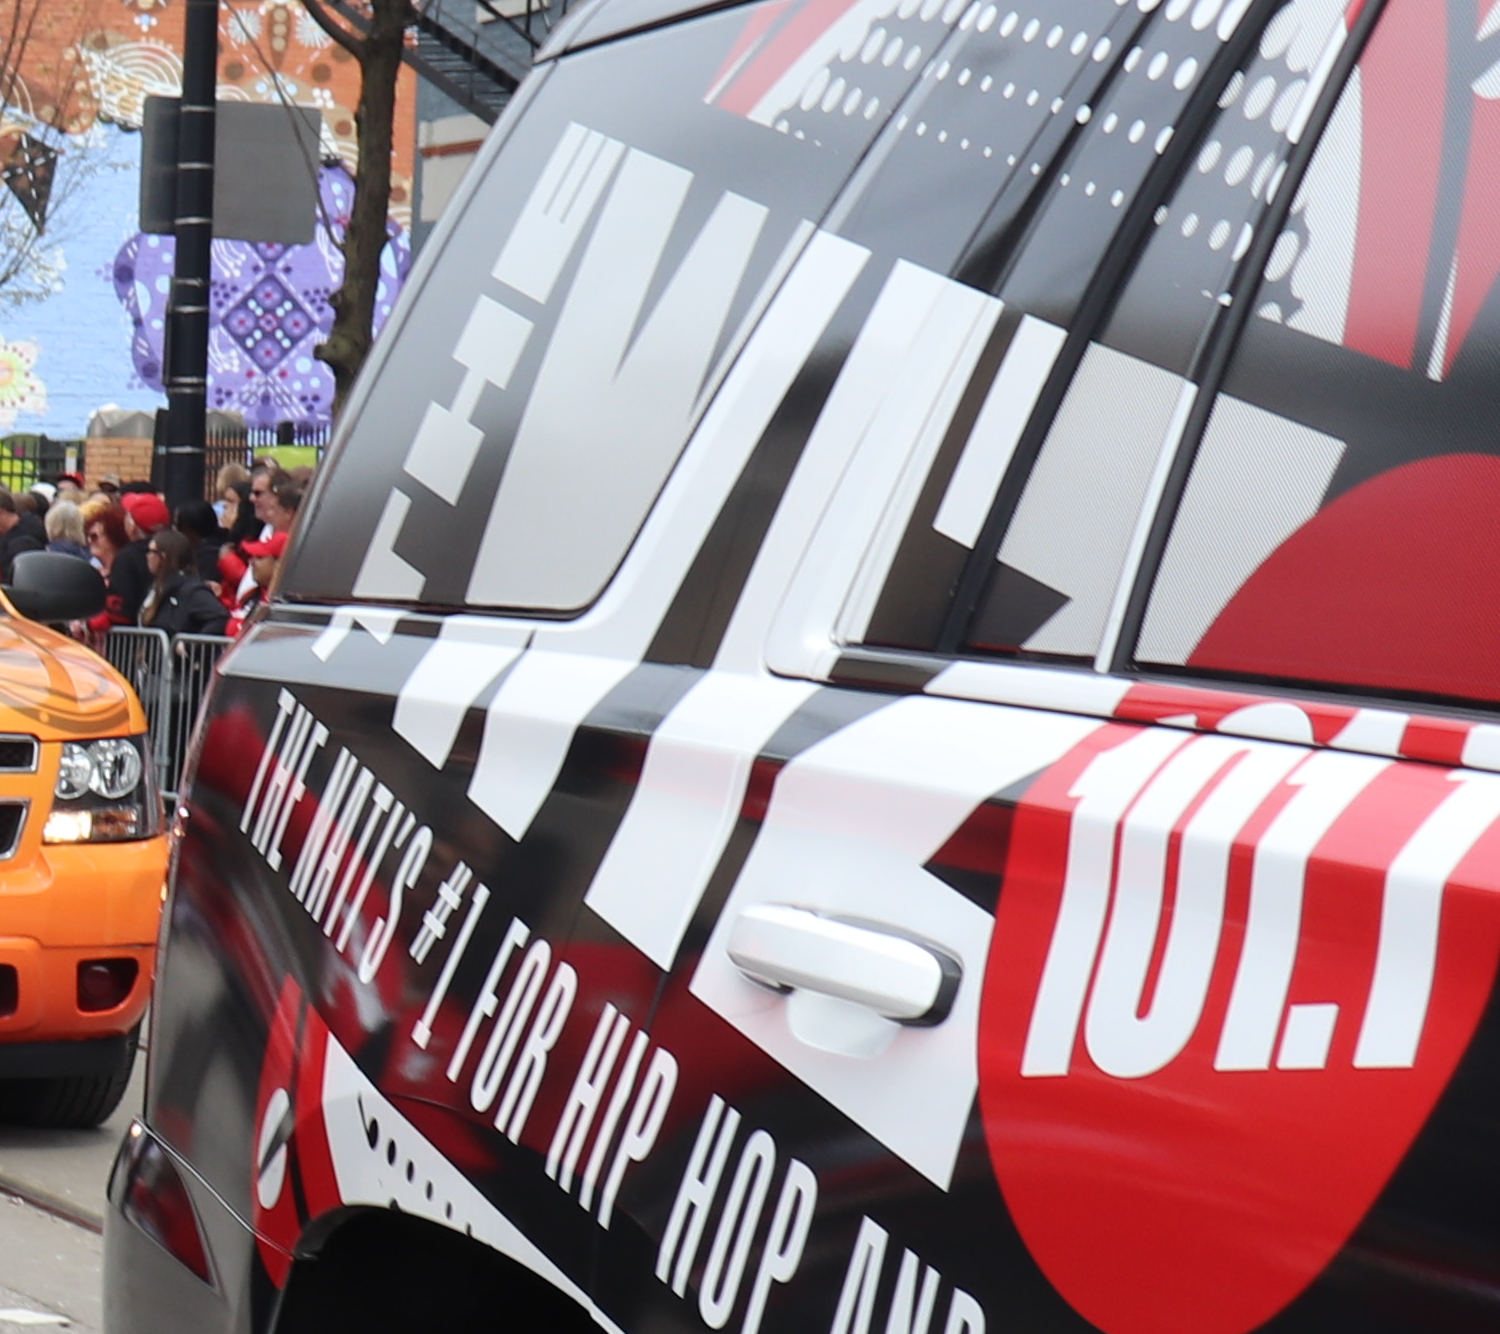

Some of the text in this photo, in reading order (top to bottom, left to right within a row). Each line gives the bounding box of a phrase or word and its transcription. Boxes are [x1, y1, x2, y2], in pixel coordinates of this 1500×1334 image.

[239, 688, 329, 872] THE
[287, 747, 434, 987] NATI'S
[1020, 702, 1500, 1078] 101.1
[407, 860, 492, 1050] #1
[445, 915, 578, 1148] FOR
[545, 1001, 679, 1231] HIP
